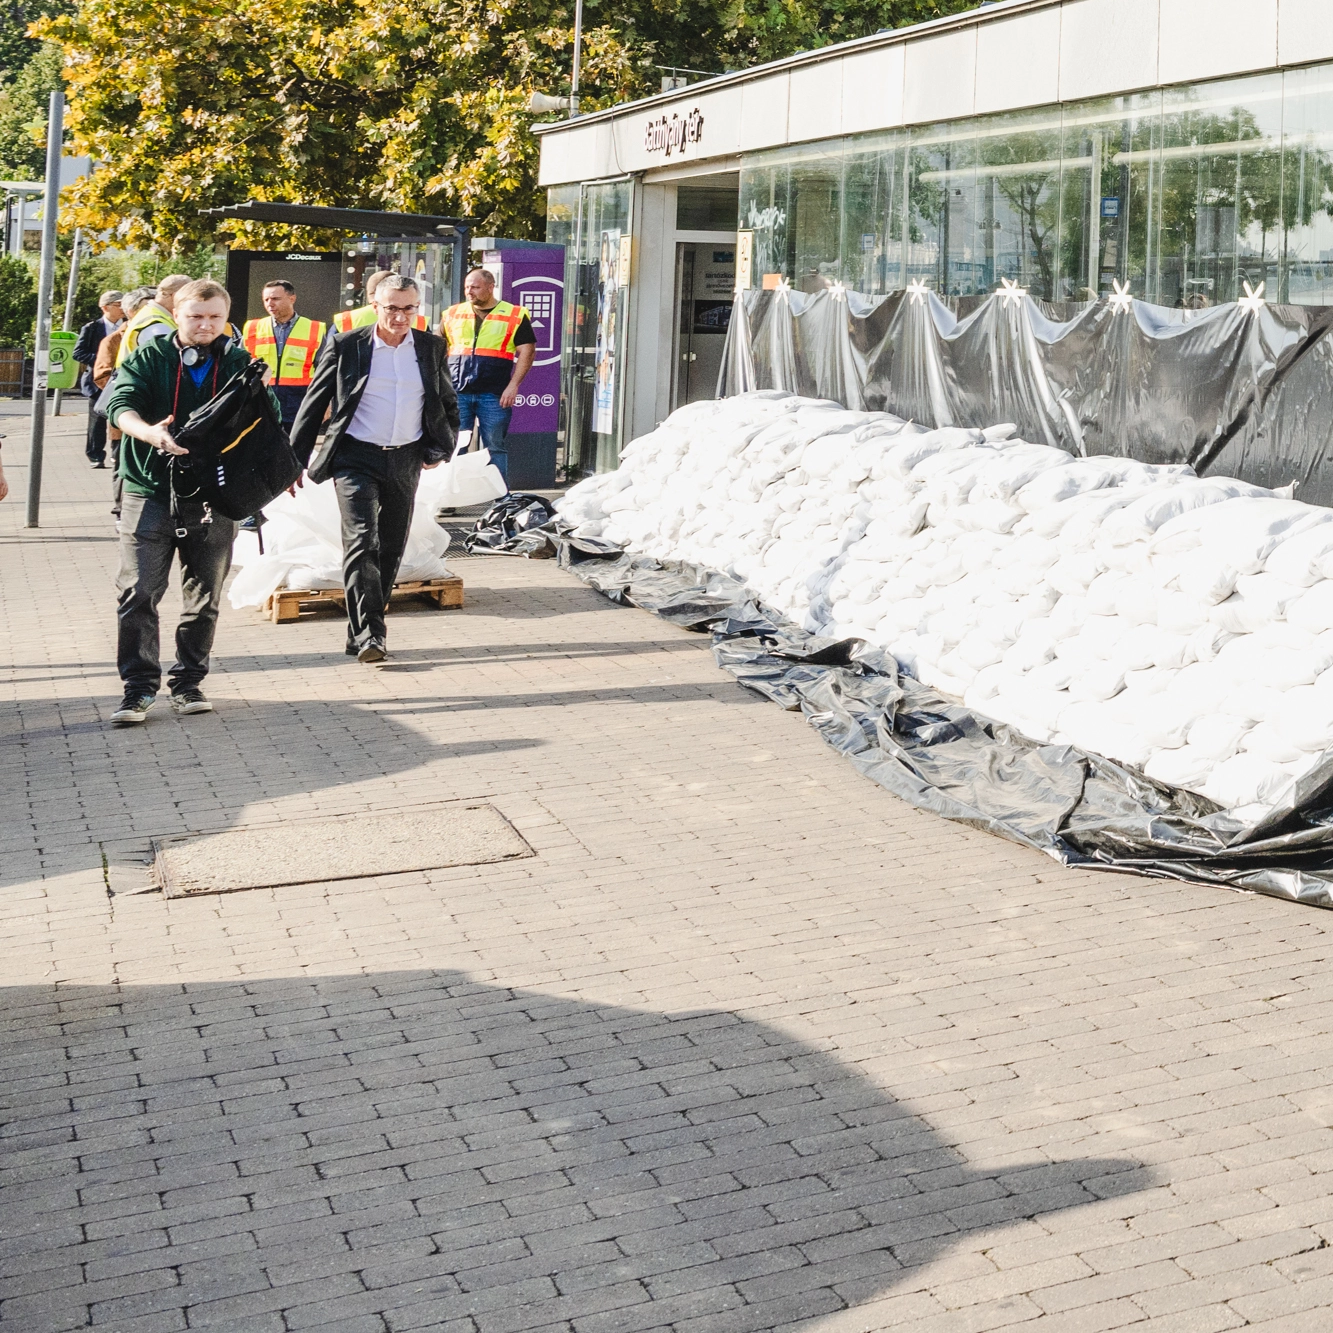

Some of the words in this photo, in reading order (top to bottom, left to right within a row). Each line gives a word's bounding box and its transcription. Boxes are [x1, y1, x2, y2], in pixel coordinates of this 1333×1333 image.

[644, 112, 687, 157] Batthyány
[687, 107, 704, 143] tér
[285, 253, 322, 261] JCDecaux
